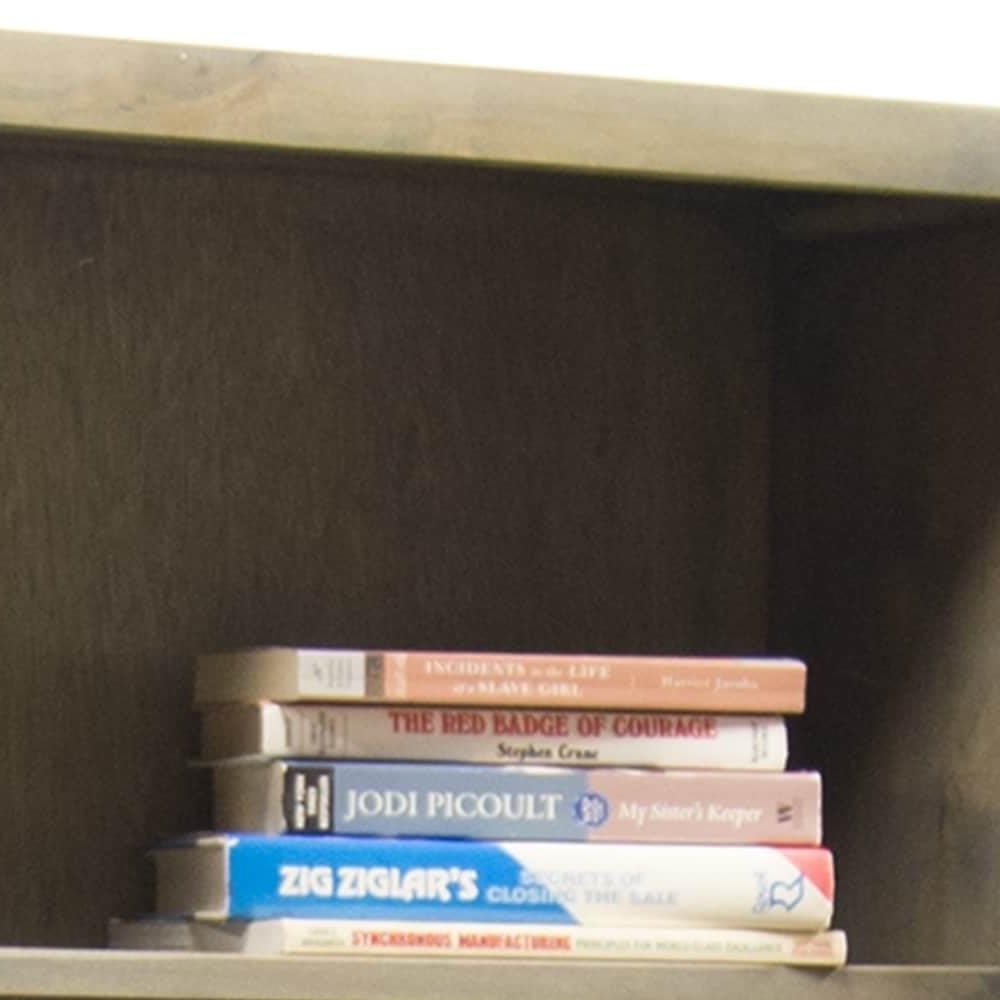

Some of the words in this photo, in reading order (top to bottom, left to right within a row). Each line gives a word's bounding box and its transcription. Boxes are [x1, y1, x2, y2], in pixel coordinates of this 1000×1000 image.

[569, 664, 611, 679] LIFE
[538, 682, 583, 698] GIRL
[388, 711, 438, 734] THE
[441, 711, 486, 735] RED
[493, 712, 569, 737] BADGE
[577, 714, 606, 738] OF
[612, 715, 718, 739] COURAGE
[497, 742, 551, 761] Stephen
[557, 743, 599, 760] Crane
[343, 789, 417, 821] JODI
[426, 791, 563, 821] PICOULT
[616, 802, 646, 826] My
[648, 800, 704, 821] Sister's
[707, 802, 763, 827] Keeper
[277, 864, 334, 897] ZIG
[336, 865, 479, 902] ZIGLAR'S
[620, 872, 643, 886] OF
[486, 886, 577, 904] CLOSING
[584, 889, 618, 904] THE
[629, 890, 679, 905] SALE
[458, 933, 572, 951] MANUFACTURING
